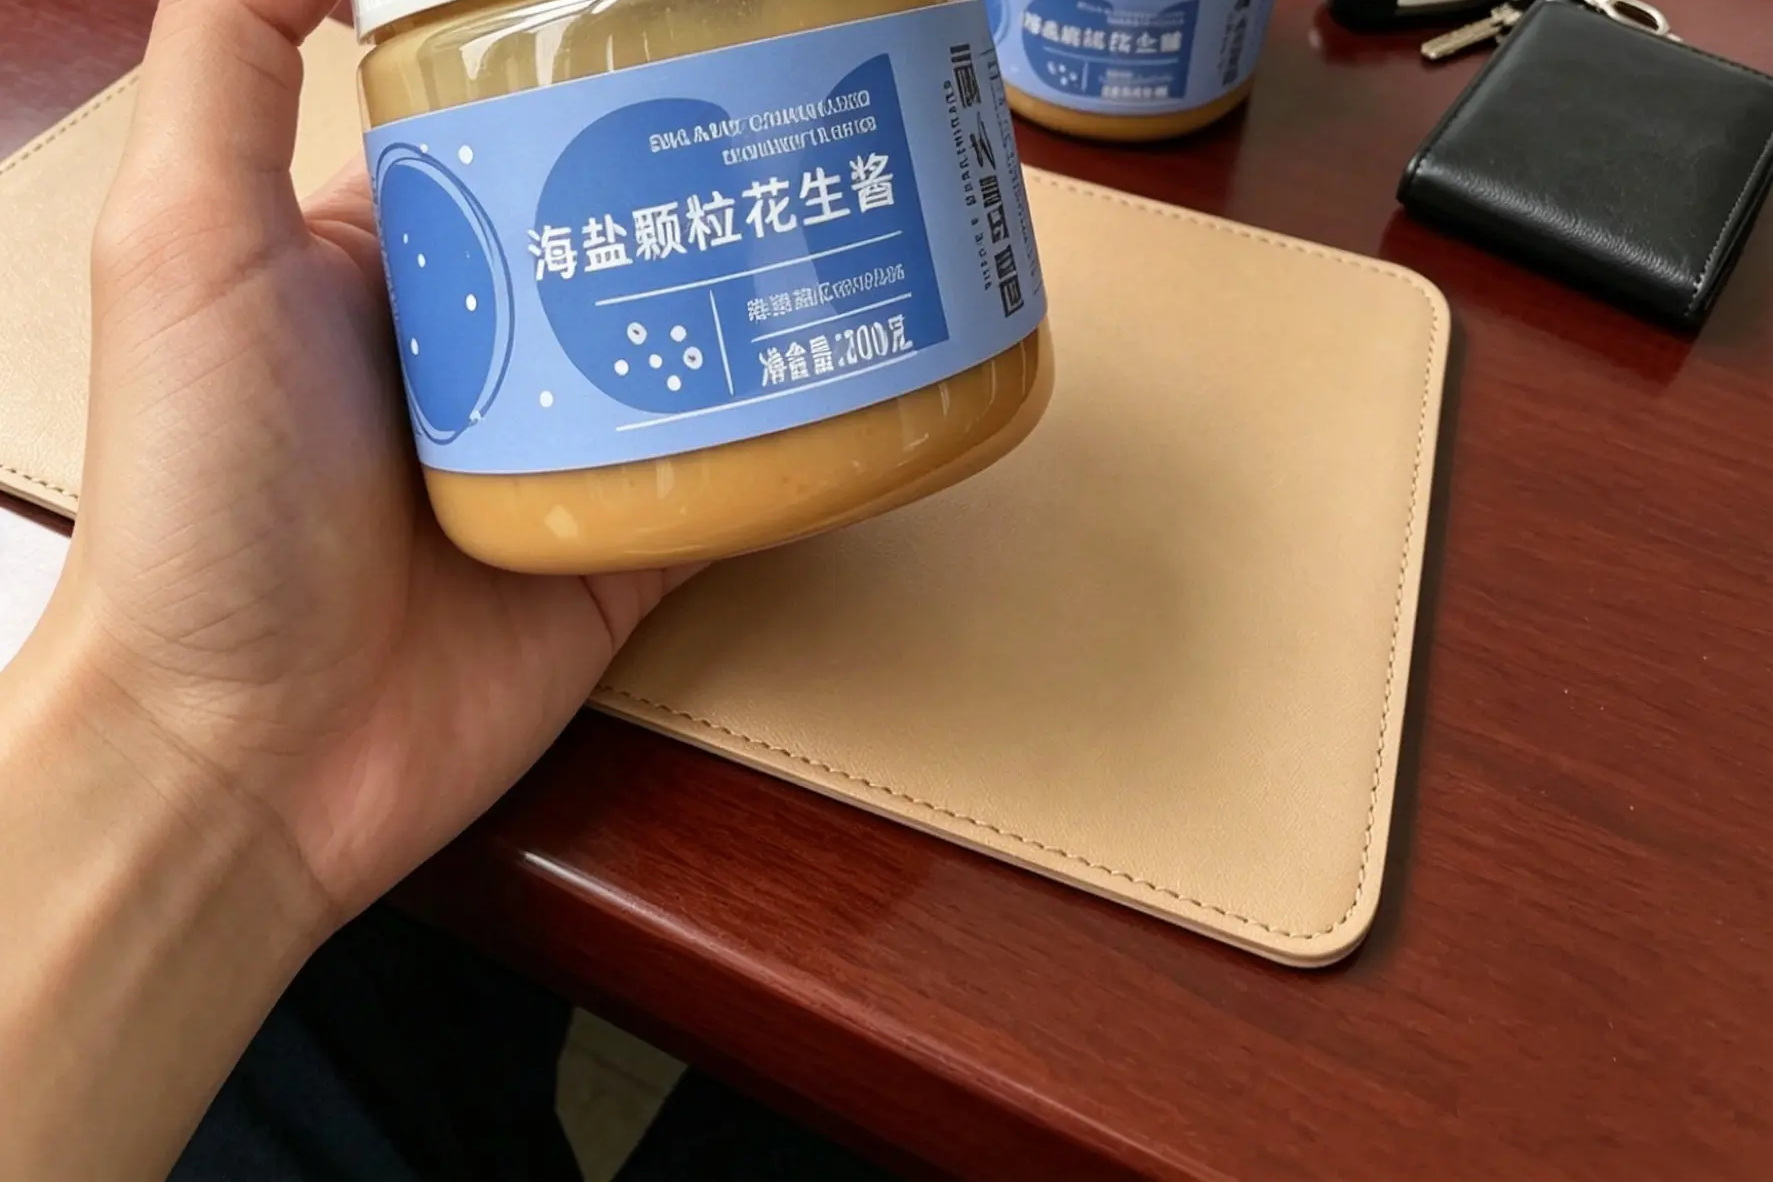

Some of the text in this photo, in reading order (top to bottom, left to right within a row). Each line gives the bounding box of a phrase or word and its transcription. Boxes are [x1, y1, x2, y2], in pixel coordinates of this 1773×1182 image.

[526, 152, 896, 281] 海盐颗粒花生酱
